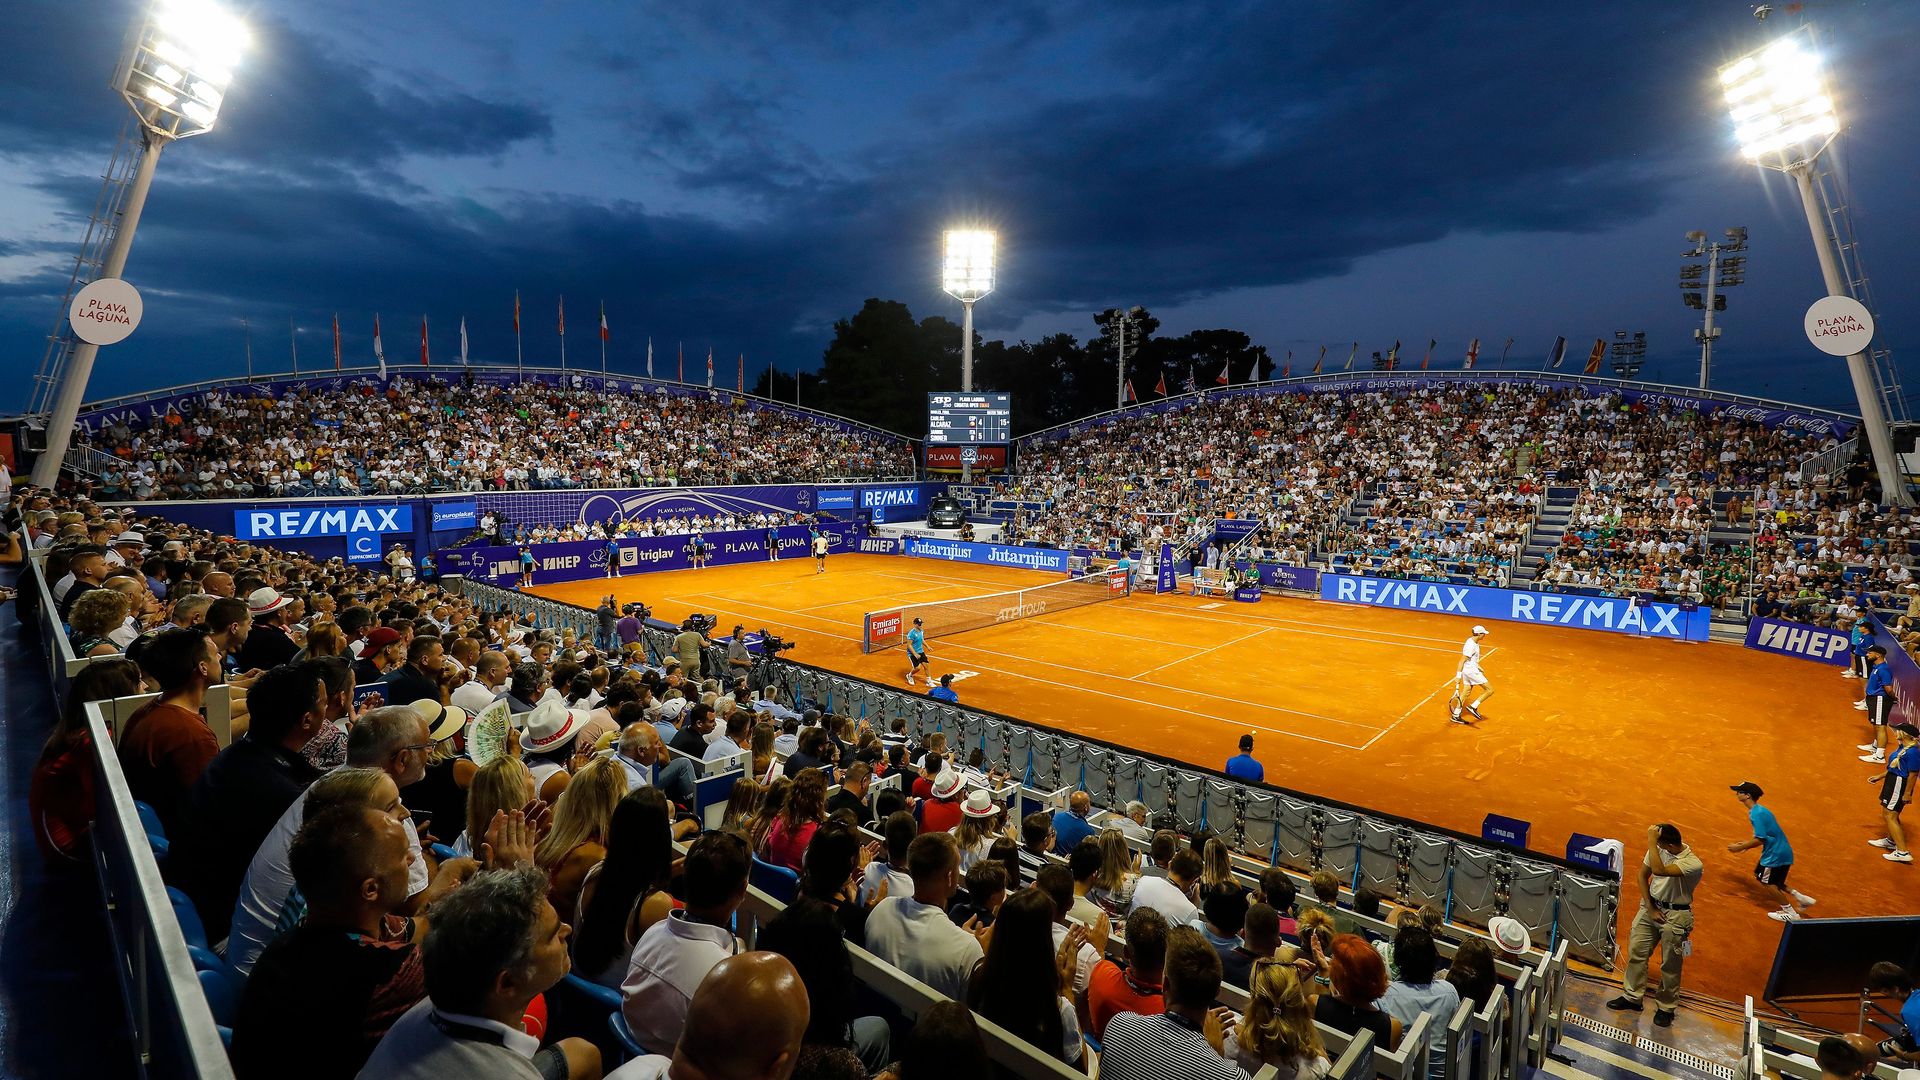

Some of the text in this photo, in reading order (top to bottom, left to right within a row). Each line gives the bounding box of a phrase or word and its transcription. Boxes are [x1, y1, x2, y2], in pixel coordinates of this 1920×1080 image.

[88, 299, 127, 314] PLAVA
[78, 308, 131, 325] LAGUNA
[1817, 315, 1856, 327] PLAVA
[1814, 323, 1866, 337] LAGUNA
[1312, 380, 1418, 392] GHIASTAFF GHIASTAFF
[928, 453, 956, 461] PLAVA
[865, 489, 915, 507] RE/MAX
[250, 508, 400, 537] RE/MAX
[355, 537, 372, 553] C
[682, 542, 717, 553] CROTIA
[725, 537, 806, 553] PLAVA LGUNA
[871, 539, 895, 553] HEP
[556, 555, 581, 570] HEP
[639, 548, 674, 563] triglav
[1020, 600, 1047, 618] TOUR
[1337, 577, 1681, 635] RE/MAX RE/MAX
[872, 617, 901, 630] Emirates
[1785, 627, 1849, 660] HEP
[730, 756, 736, 767] 6
